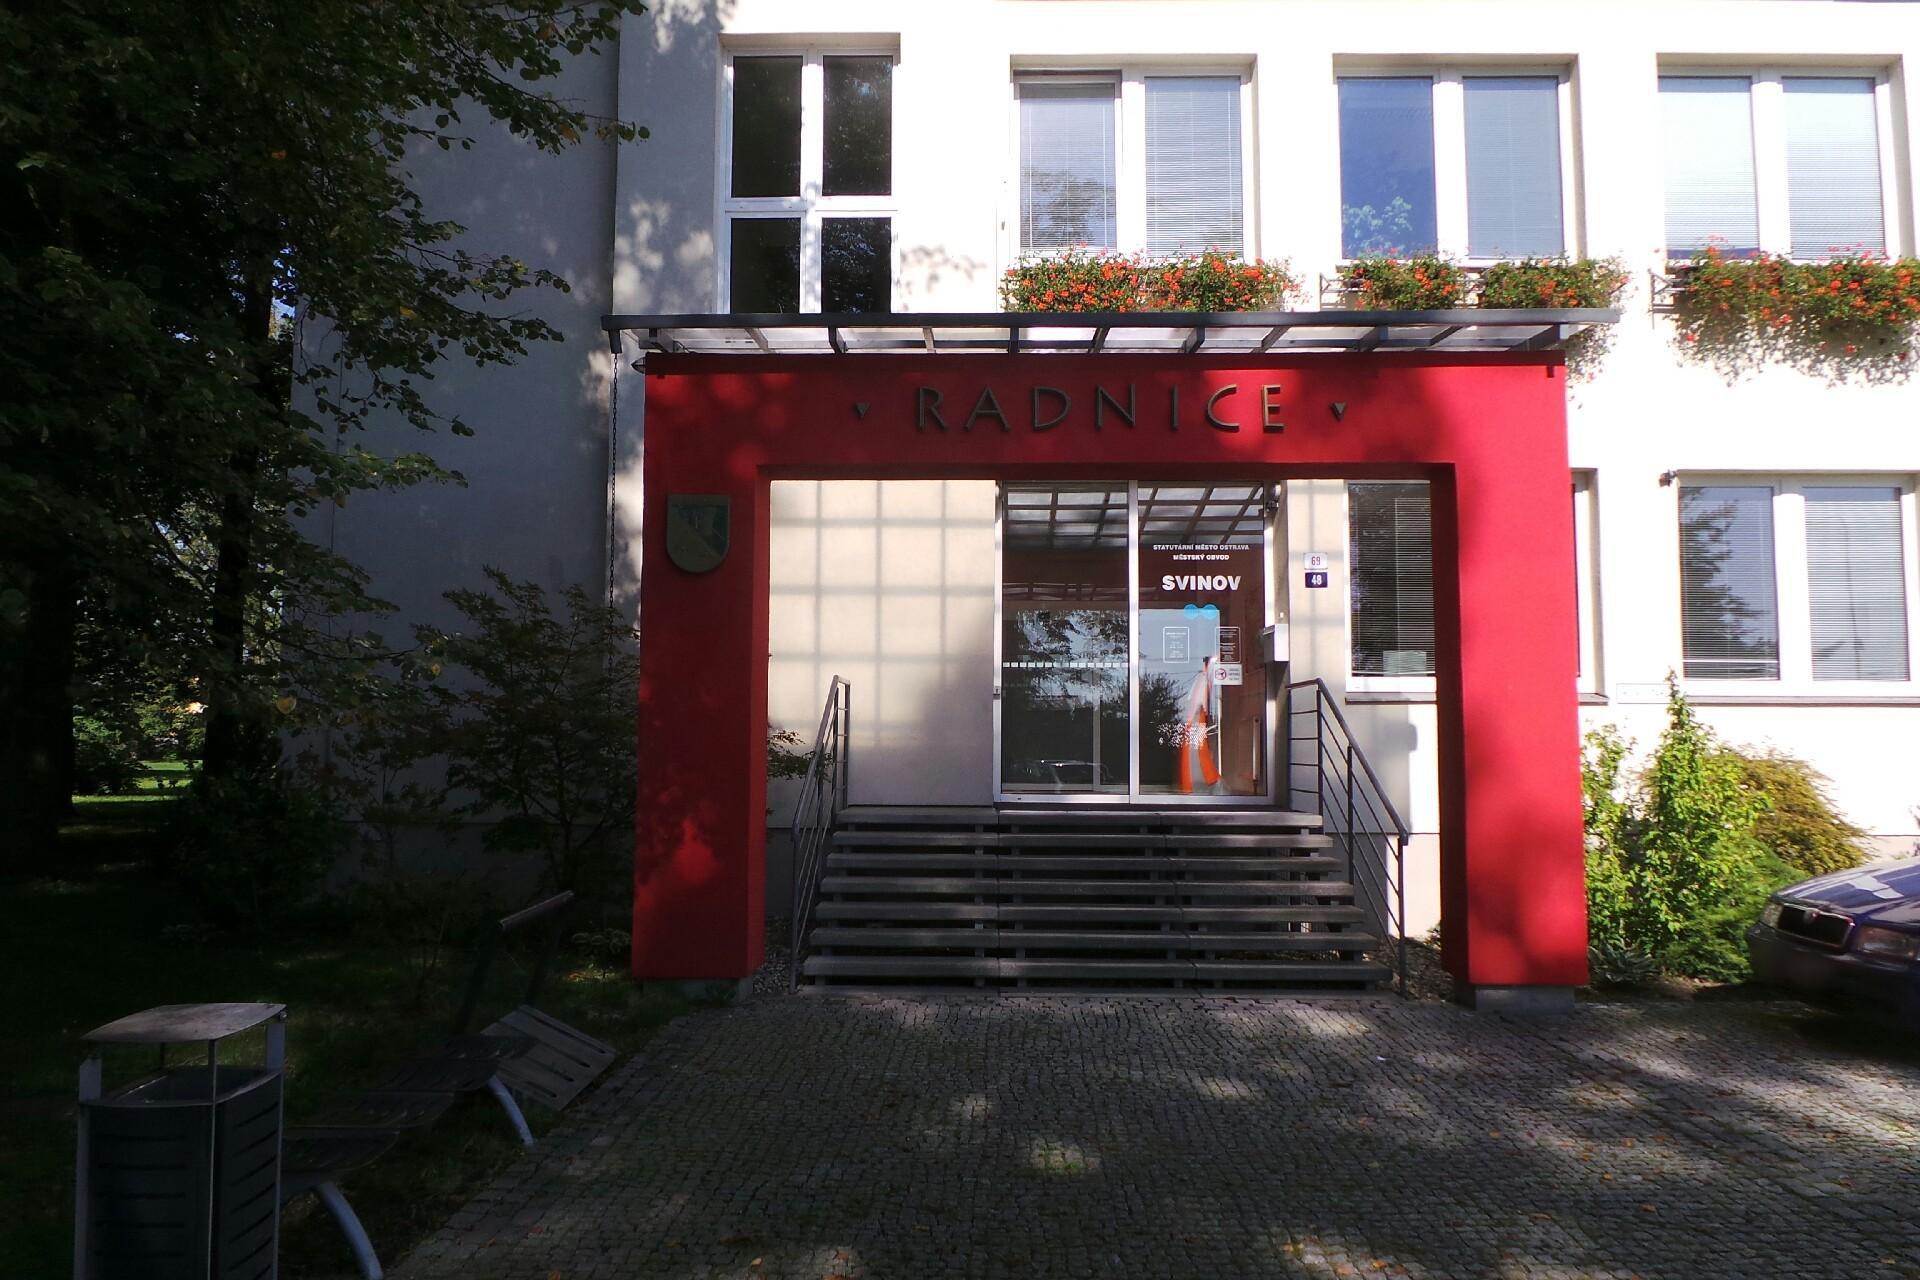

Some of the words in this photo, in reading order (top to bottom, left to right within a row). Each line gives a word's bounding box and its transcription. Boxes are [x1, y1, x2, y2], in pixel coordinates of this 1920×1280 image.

[918, 384, 1285, 433] RADNICE
[1311, 556, 1321, 566] 69
[1162, 575, 1241, 591] SVINOV
[1311, 574, 1322, 585] 48
